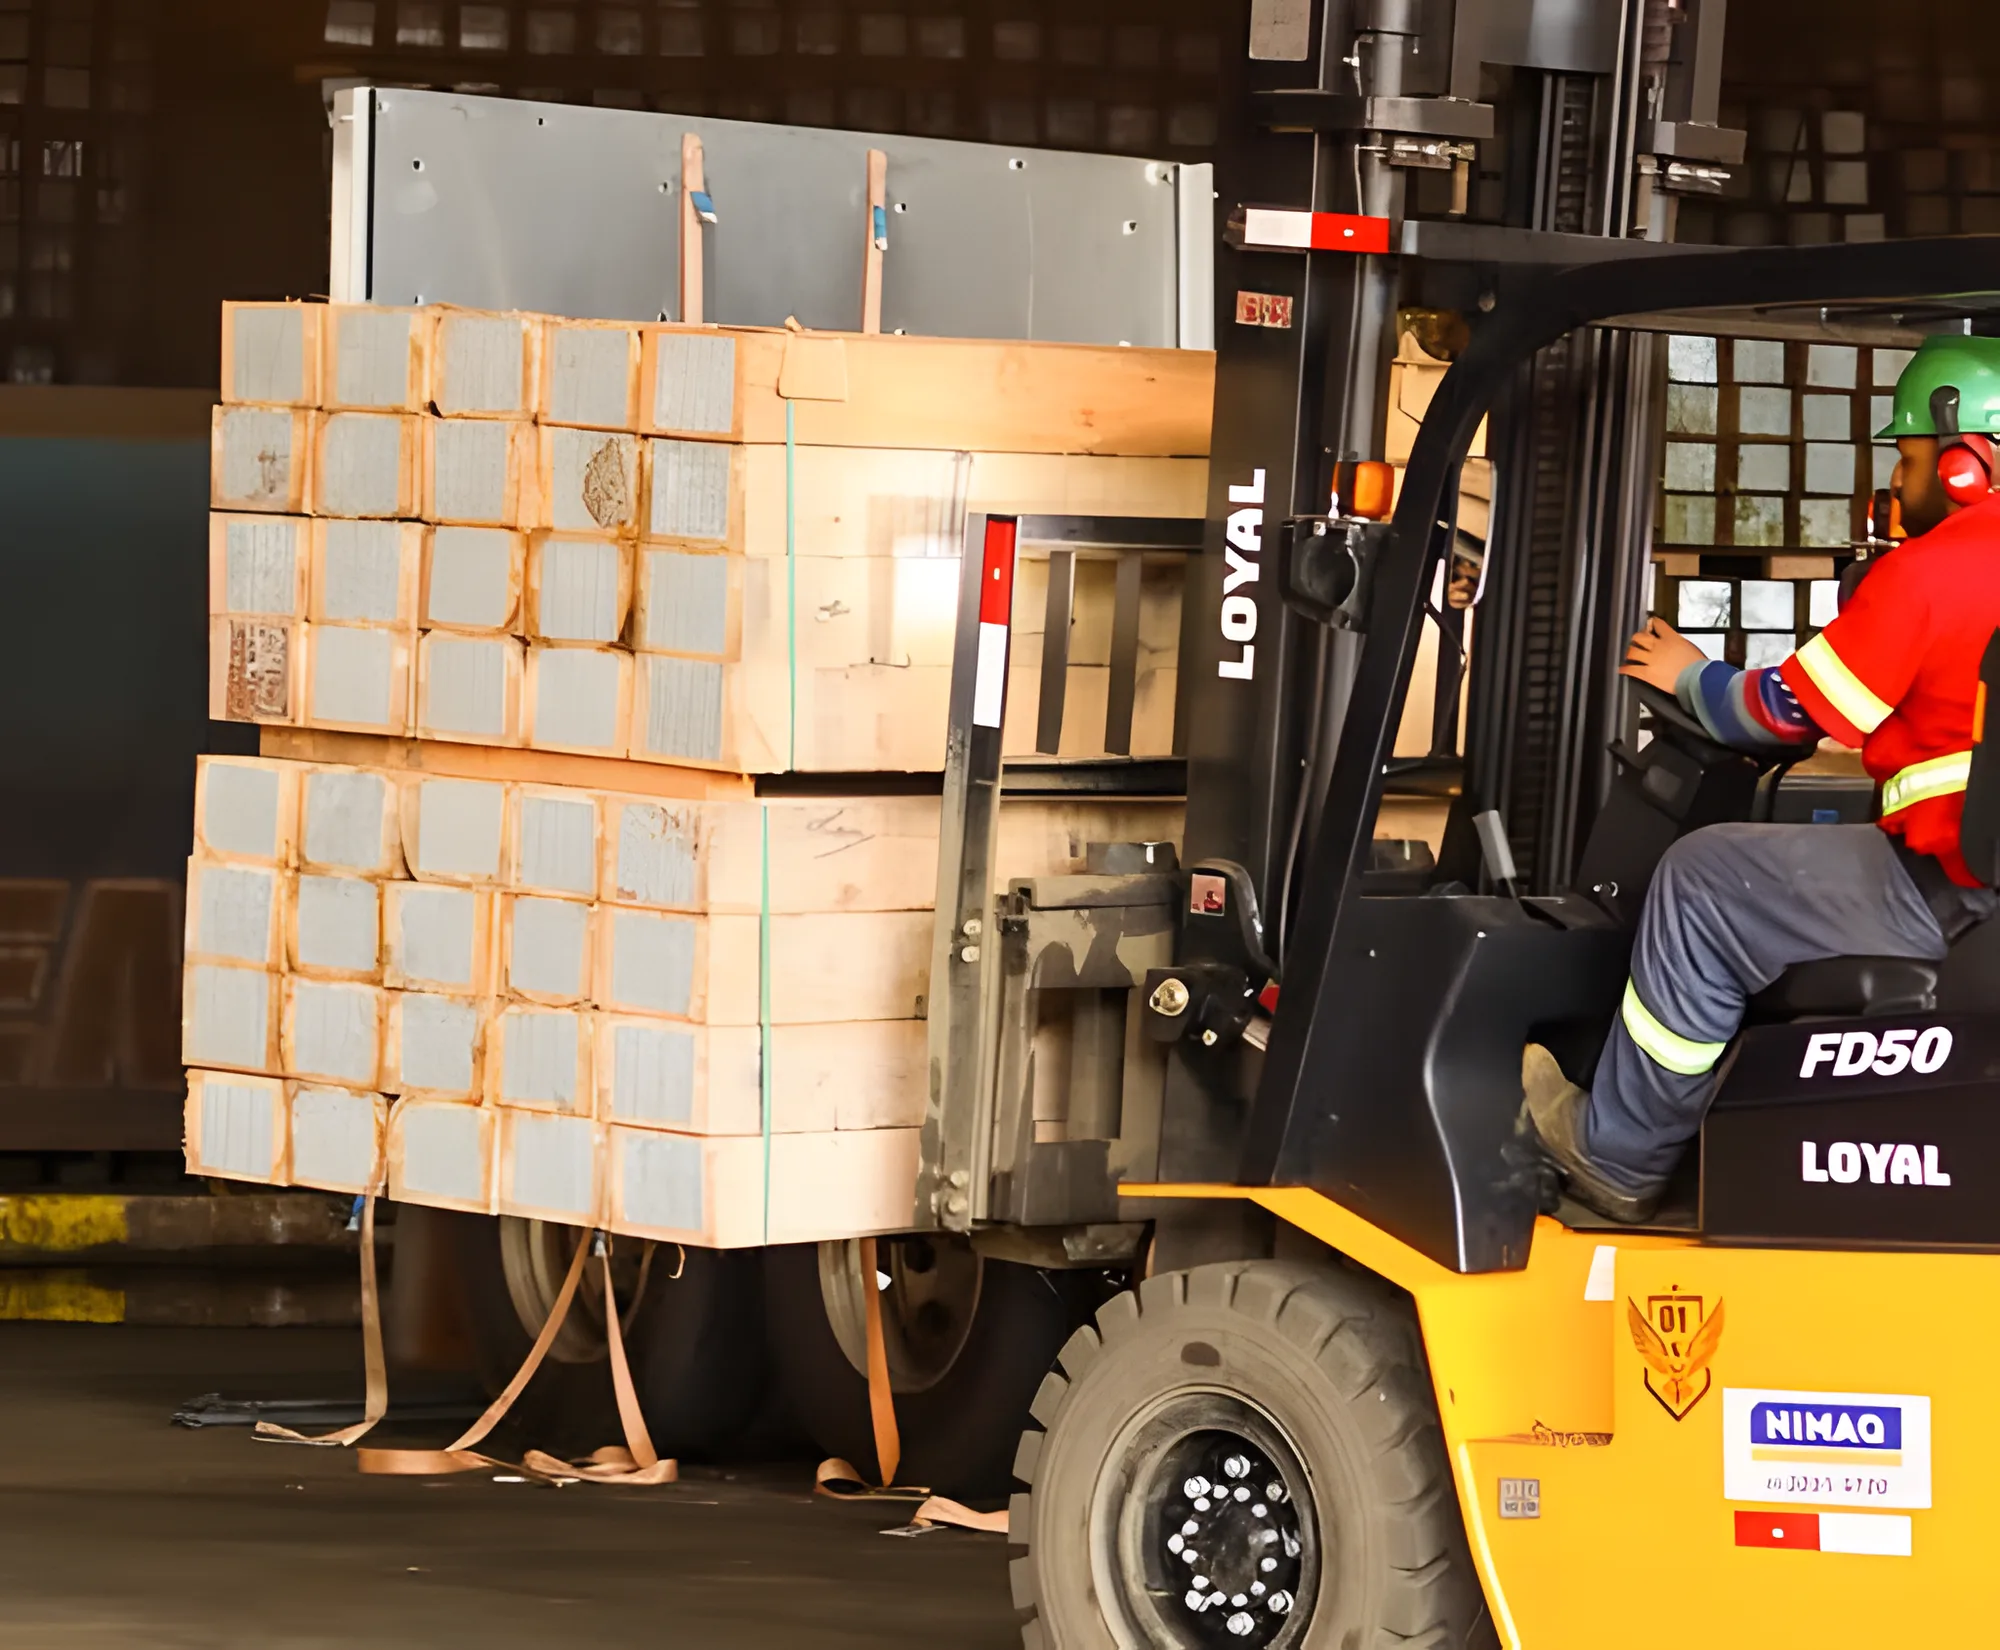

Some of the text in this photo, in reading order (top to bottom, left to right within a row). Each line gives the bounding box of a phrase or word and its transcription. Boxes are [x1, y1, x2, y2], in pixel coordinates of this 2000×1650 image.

[1218, 468, 1266, 680] LOYAL
[1799, 1026, 1953, 1078] FD50
[1802, 1141, 1951, 1187] LOYAL
